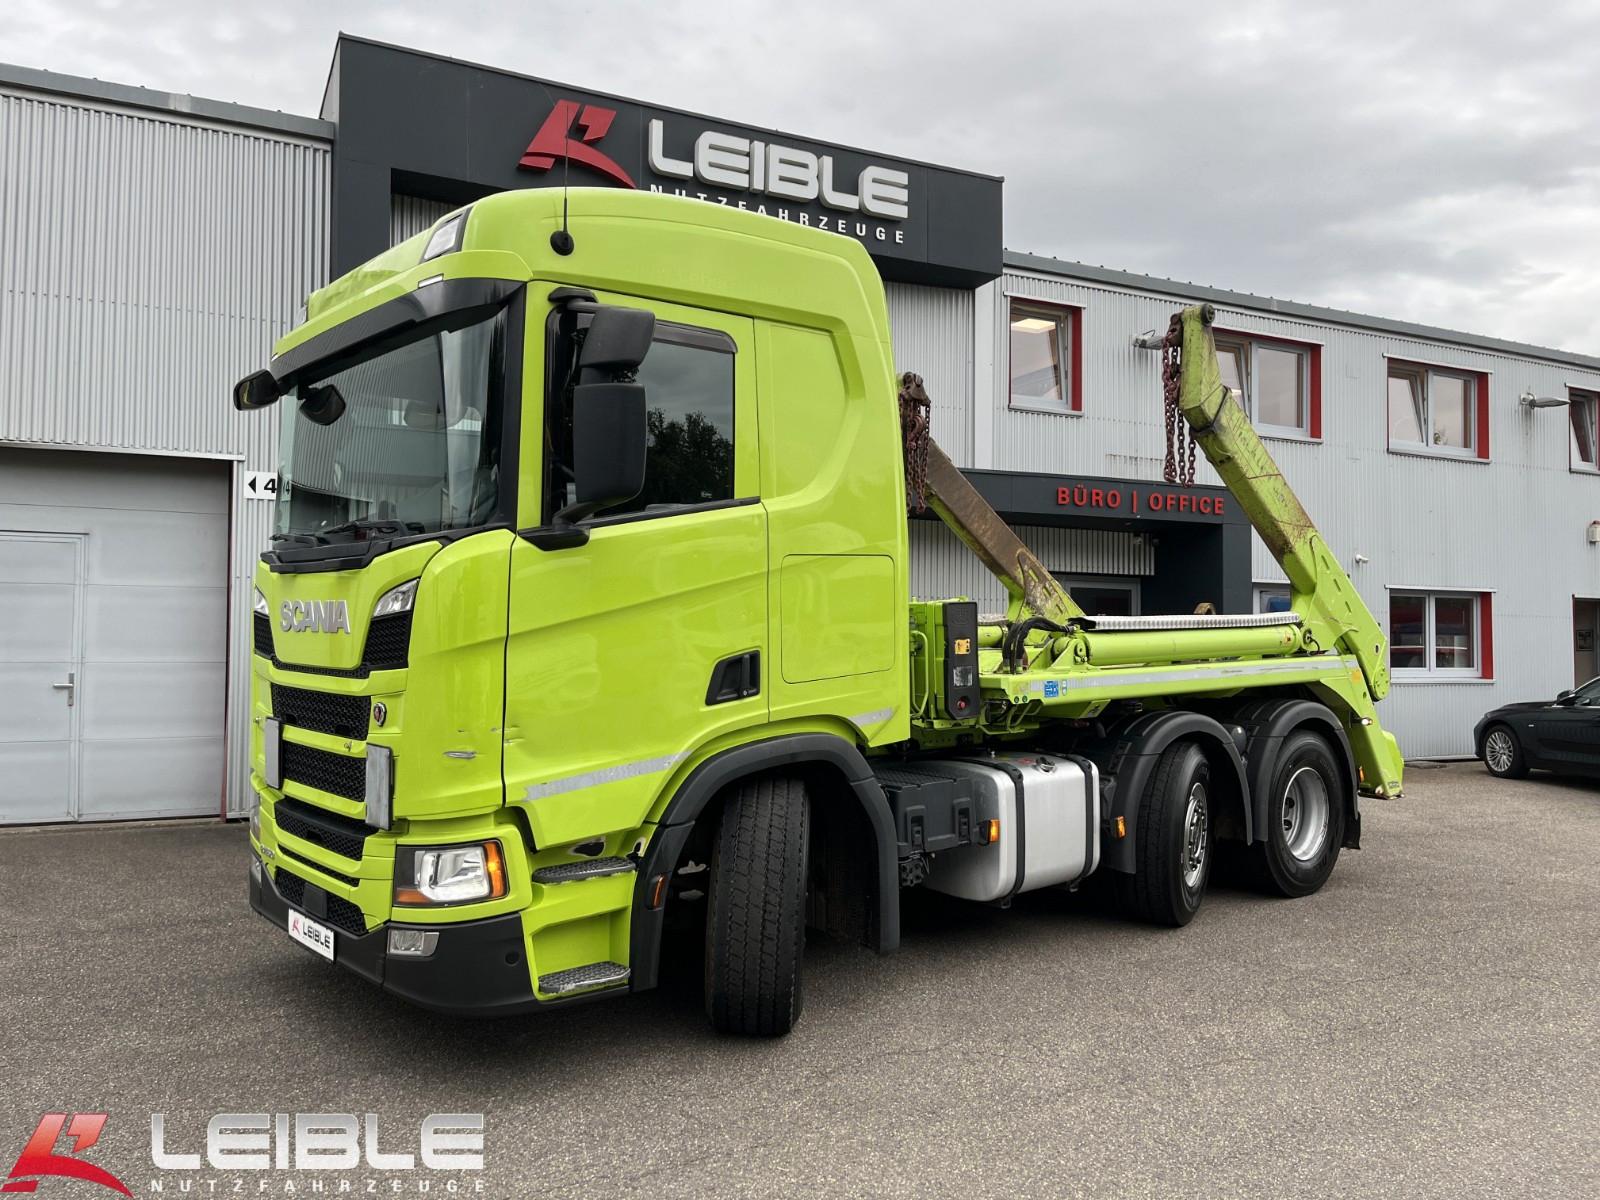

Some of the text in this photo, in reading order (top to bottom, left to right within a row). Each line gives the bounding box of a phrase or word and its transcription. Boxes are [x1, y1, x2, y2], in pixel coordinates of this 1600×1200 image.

[648, 119, 909, 220] LEIBLE
[263, 478, 277, 494] 4
[1056, 484, 1121, 509] BÜRO
[1149, 492, 1225, 515] OFFICE
[281, 599, 351, 634] SCANIA
[302, 920, 331, 950] LEIBLE
